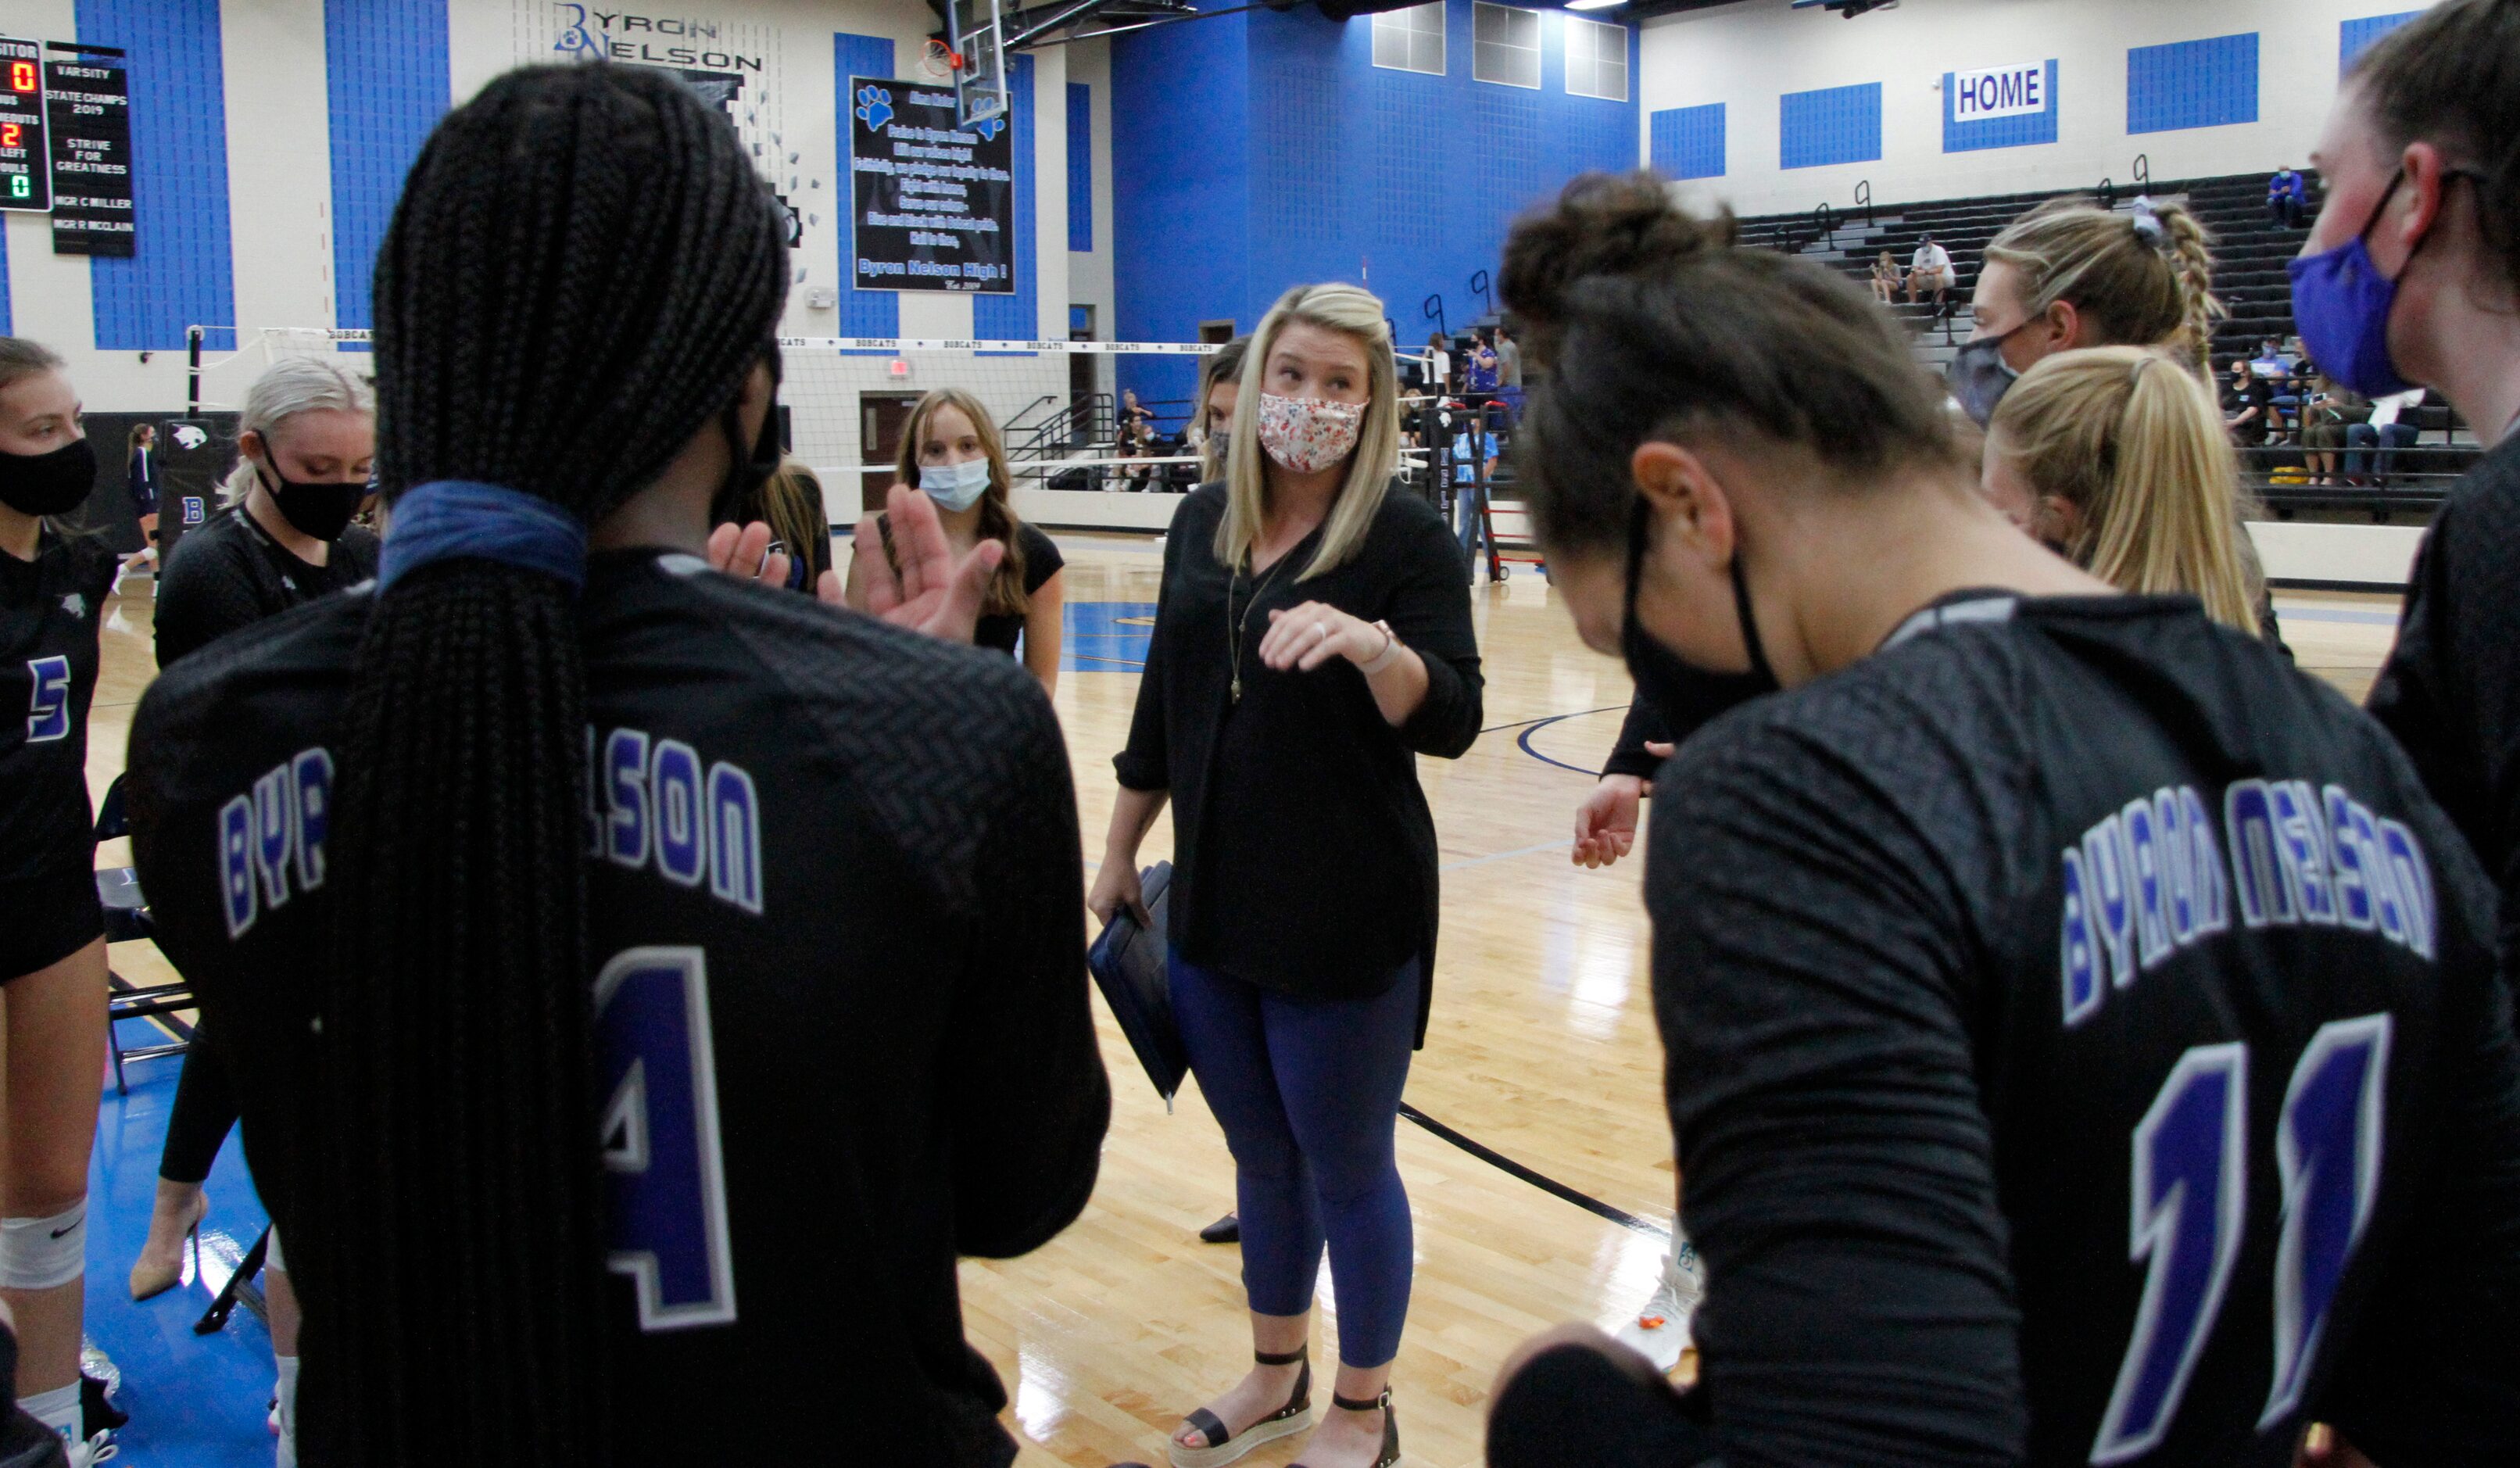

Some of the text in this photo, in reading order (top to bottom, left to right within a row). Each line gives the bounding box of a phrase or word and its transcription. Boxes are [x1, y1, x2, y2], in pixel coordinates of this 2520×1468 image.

[553, 2, 717, 52] BYRON
[0, 42, 38, 59] ITOR
[575, 30, 761, 72] NELSON
[12, 62, 36, 92] 0
[56, 66, 110, 79] VARSITY
[45, 90, 127, 106] STATE CHAMPS
[1960, 69, 2039, 114] HOME
[73, 105, 105, 116] 2019
[2, 124, 21, 148] 2
[66, 138, 111, 151] STRIVE
[1, 147, 27, 158] LEFT
[76, 150, 102, 162] FOR
[56, 162, 127, 175] GREATNESS
[12, 174, 30, 198] 0
[80, 197, 89, 207] C
[89, 198, 132, 209] MILLER
[78, 220, 87, 230] R
[858, 258, 905, 277] Byron
[907, 260, 961, 277] Nelson
[963, 262, 997, 281] High
[329, 330, 375, 339] BOBCAT
[183, 496, 205, 525] B
[27, 655, 70, 742] 5
[586, 723, 764, 916] SON
[2089, 1012, 2393, 1466] 11
